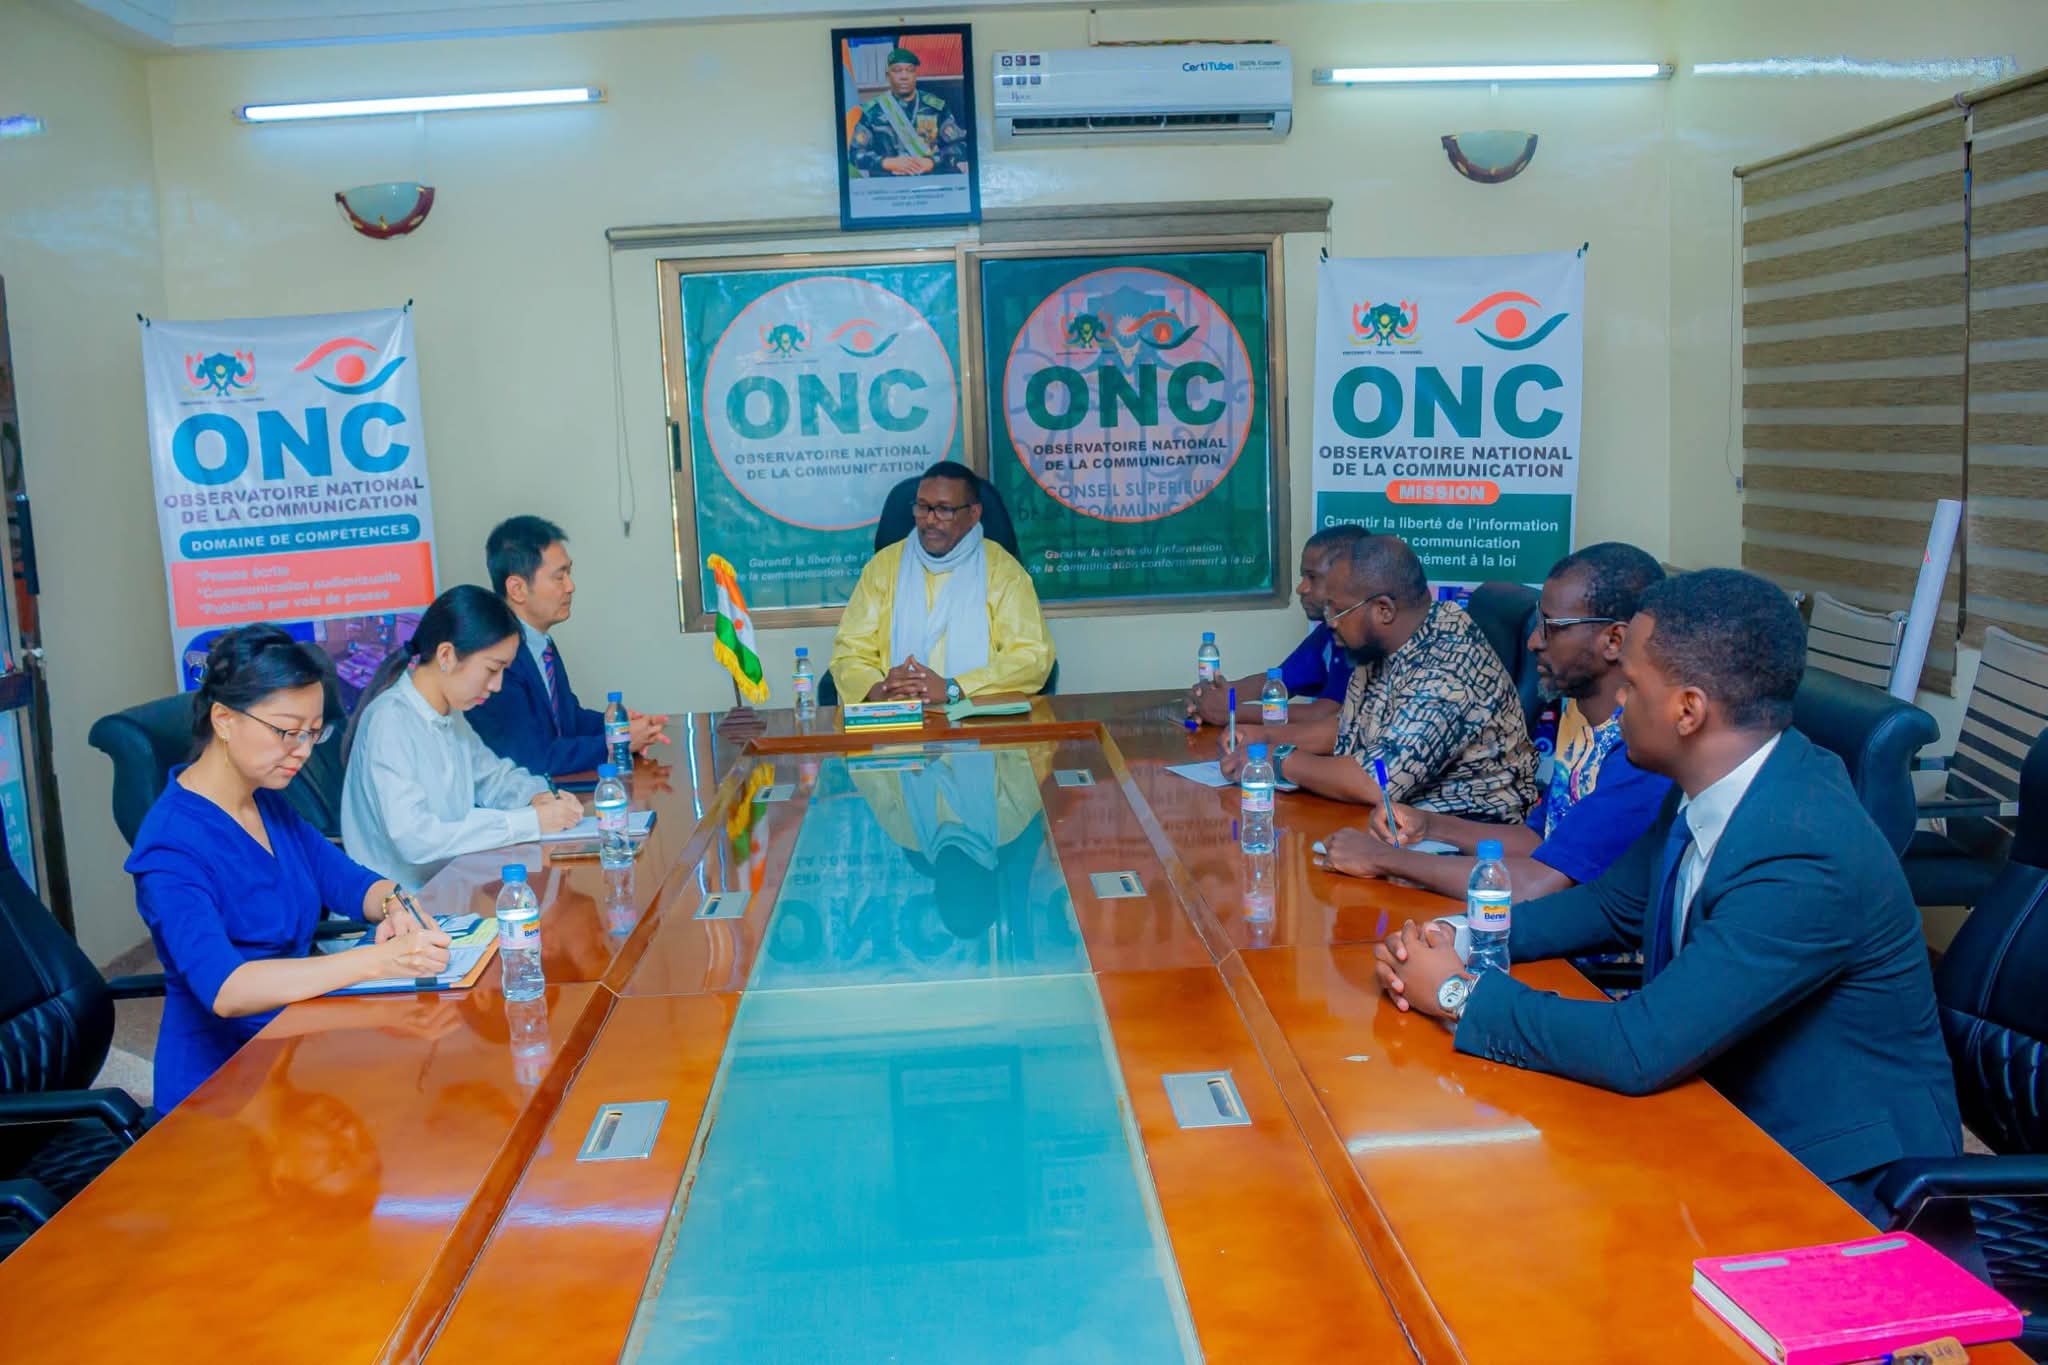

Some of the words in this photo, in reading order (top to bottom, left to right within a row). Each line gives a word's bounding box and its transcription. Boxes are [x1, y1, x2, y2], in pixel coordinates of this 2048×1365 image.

[1182, 61, 1234, 72] CertiTube
[726, 368, 929, 441] ONC
[1026, 363, 1227, 431] ONC
[1332, 364, 1564, 439] ONC
[171, 402, 410, 485] ONC
[1033, 442, 1146, 455] OBSERVATOIRE
[1152, 438, 1227, 451] NATIONAL
[735, 449, 850, 465] OBSERVATOIRE
[855, 445, 931, 458] NATIONAL
[1045, 460, 1065, 471] DE
[1069, 459, 1087, 470] LA
[1093, 454, 1221, 469] COMMUNICATION
[1319, 446, 1465, 460] OBSERVATOIRE
[1472, 446, 1573, 461] NATIONAL
[747, 469, 767, 480] DE
[771, 468, 790, 479] LA
[795, 461, 925, 478] COMMUNICATION
[1332, 463, 1356, 476] DE
[1363, 463, 1386, 476] LA
[1392, 463, 1564, 478] COMMUNICATION
[165, 485, 319, 509] OBSERVATOIRE
[326, 477, 424, 497] NATIONAL
[1400, 485, 1486, 500] MISSION
[181, 509, 209, 525] DE
[215, 508, 241, 523] LA
[247, 493, 418, 520] COMMUNICATION
[1324, 514, 1380, 528] Garantir
[1383, 516, 1395, 529] la
[1400, 516, 1442, 530] liberté
[1446, 518, 1463, 530] de
[1468, 518, 1558, 532] l'information
[191, 535, 264, 551] DOMAINE
[270, 533, 290, 545] DE
[1412, 536, 1521, 550] communication
[1470, 553, 1479, 566] à
[1483, 554, 1494, 567] la
[1499, 554, 1516, 567] loi
